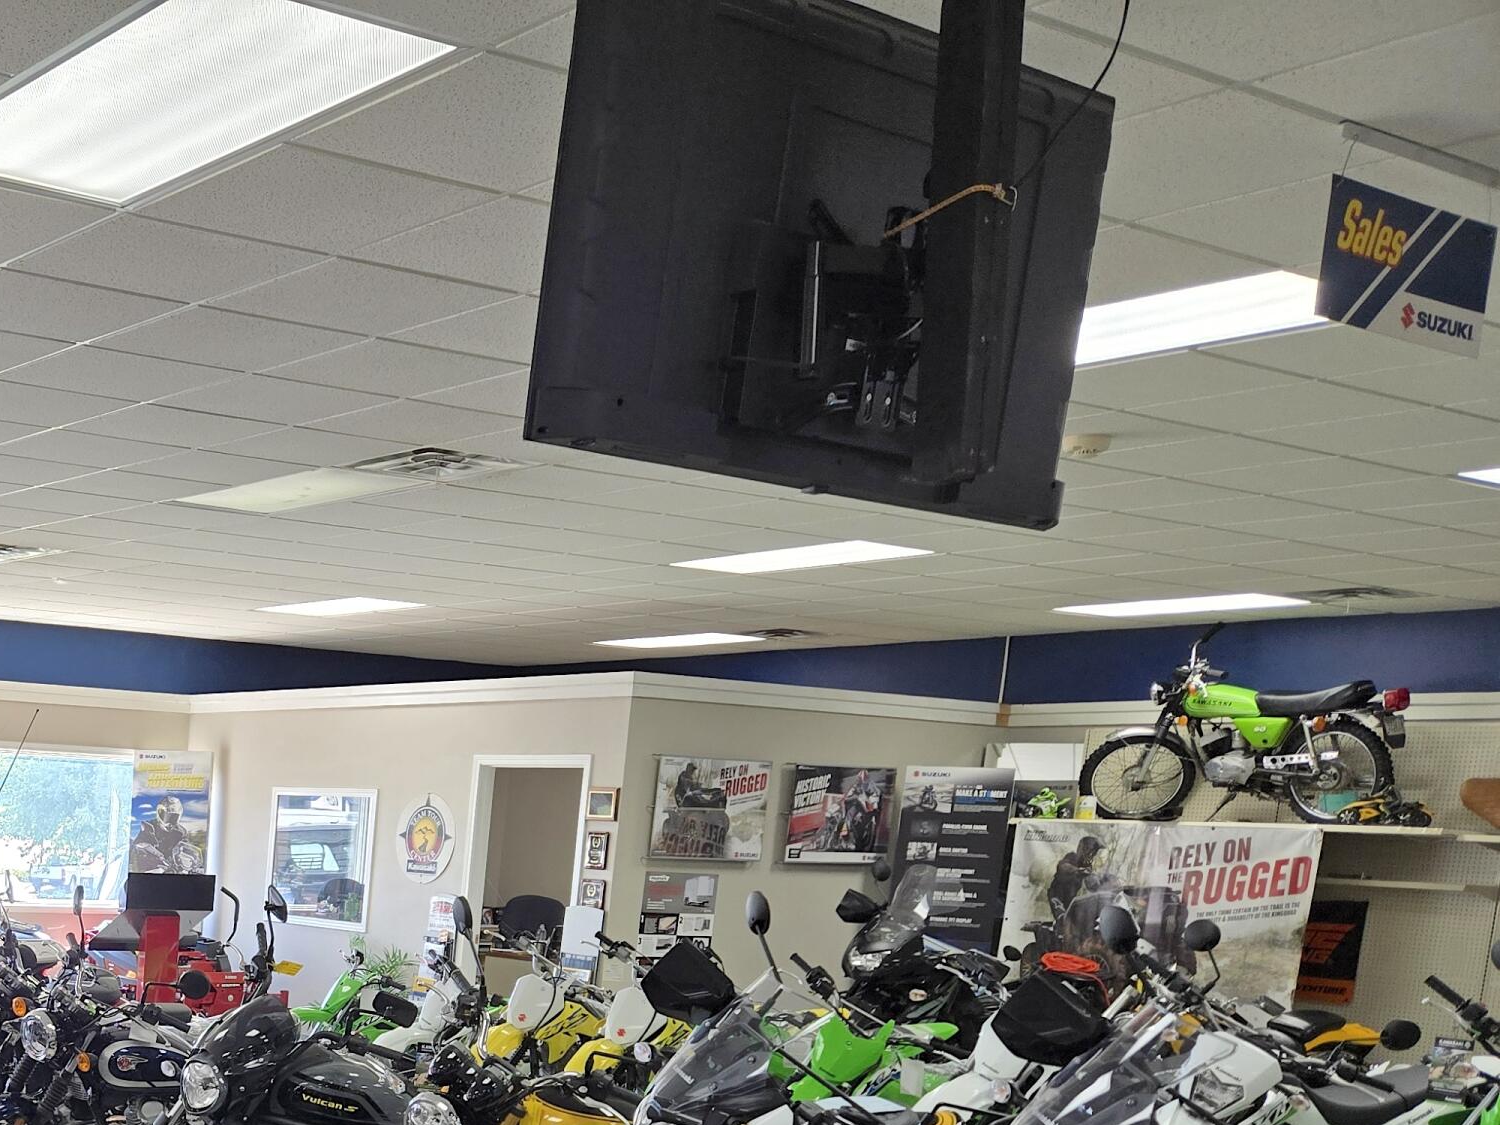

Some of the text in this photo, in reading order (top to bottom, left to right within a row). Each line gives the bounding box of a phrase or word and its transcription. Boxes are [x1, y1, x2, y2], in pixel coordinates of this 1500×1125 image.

[1337, 199, 1407, 266] Sales
[1417, 311, 1473, 340] SUZUKI
[720, 764, 749, 780] RELY ON
[795, 773, 831, 795] HISTORIC
[725, 773, 768, 797] RUGGED
[1168, 837, 1252, 870] RELY ON
[1167, 872, 1183, 884] THE
[1182, 856, 1313, 906] RUGGED
[302, 1093, 342, 1110] Vulcan
